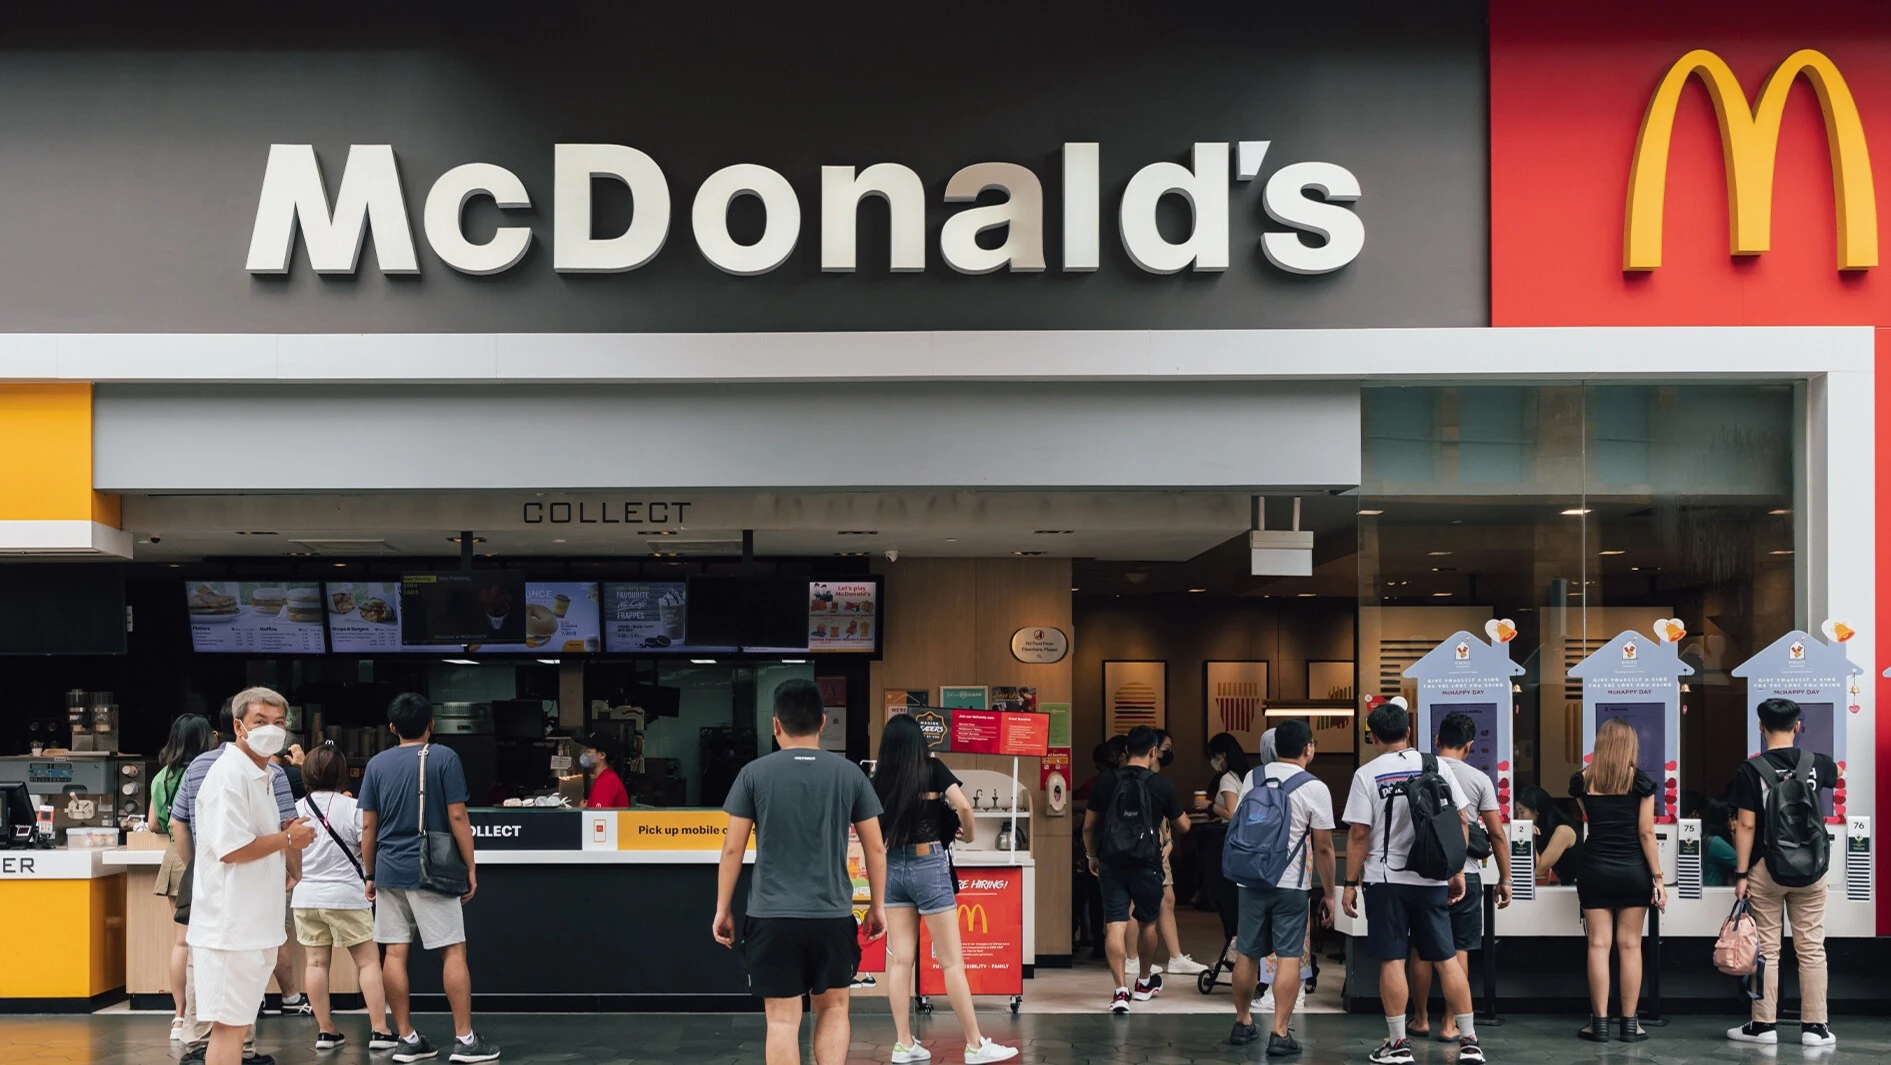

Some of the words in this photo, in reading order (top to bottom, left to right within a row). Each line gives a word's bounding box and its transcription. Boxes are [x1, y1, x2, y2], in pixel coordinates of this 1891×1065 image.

[246, 141, 1365, 275] McDonald's
[524, 502, 692, 524] COLLECT
[616, 591, 650, 599] FAVOURITE
[920, 725, 944, 733] EADERS
[1519, 825, 1524, 833] 2
[1684, 824, 1695, 833] 75
[1854, 821, 1865, 830] 76
[470, 825, 522, 837] LLECT
[638, 825, 662, 835] Pick
[665, 827, 679, 837] up
[681, 825, 720, 835] mobile
[970, 879, 1009, 890] HIRING!
